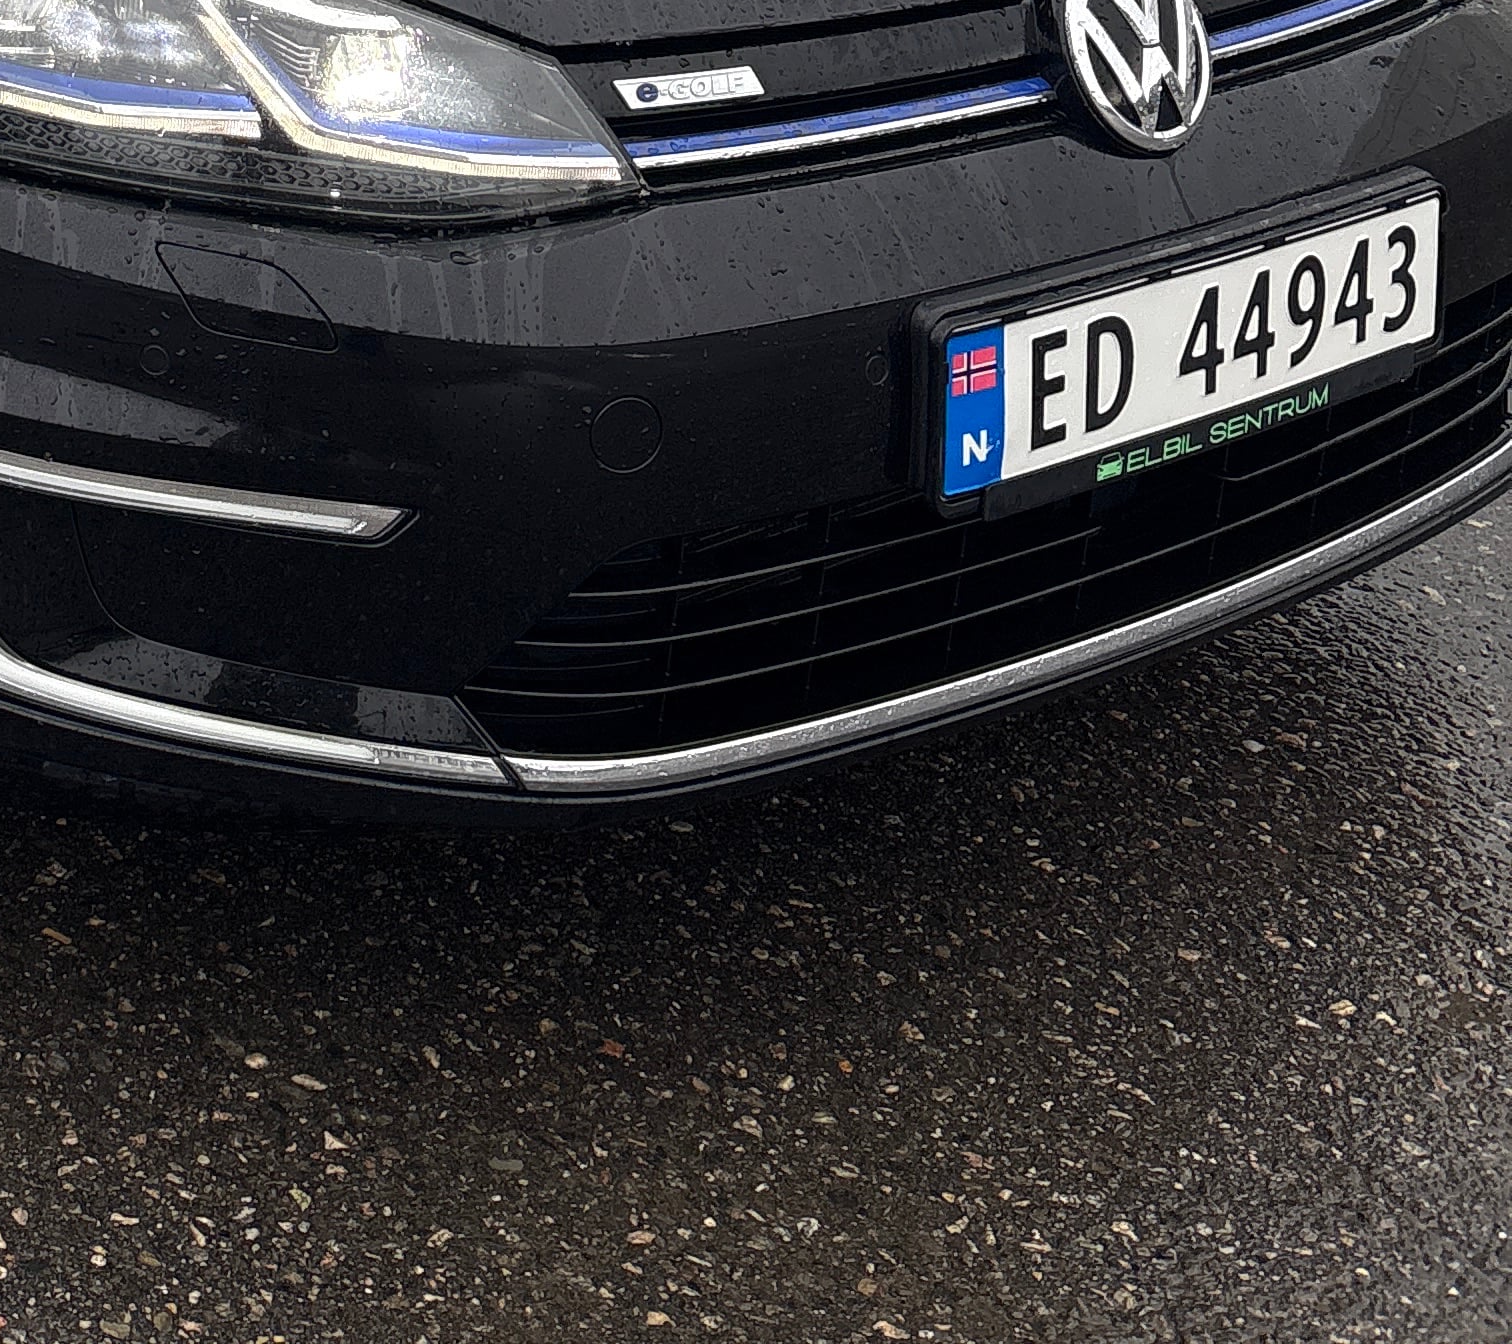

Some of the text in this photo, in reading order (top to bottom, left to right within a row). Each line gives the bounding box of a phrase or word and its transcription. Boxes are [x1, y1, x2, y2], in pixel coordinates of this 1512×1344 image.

[1031, 224, 1418, 451] ED 44943
[962, 430, 988, 466] N
[1126, 382, 1329, 473] ELBIL SENTRUM
